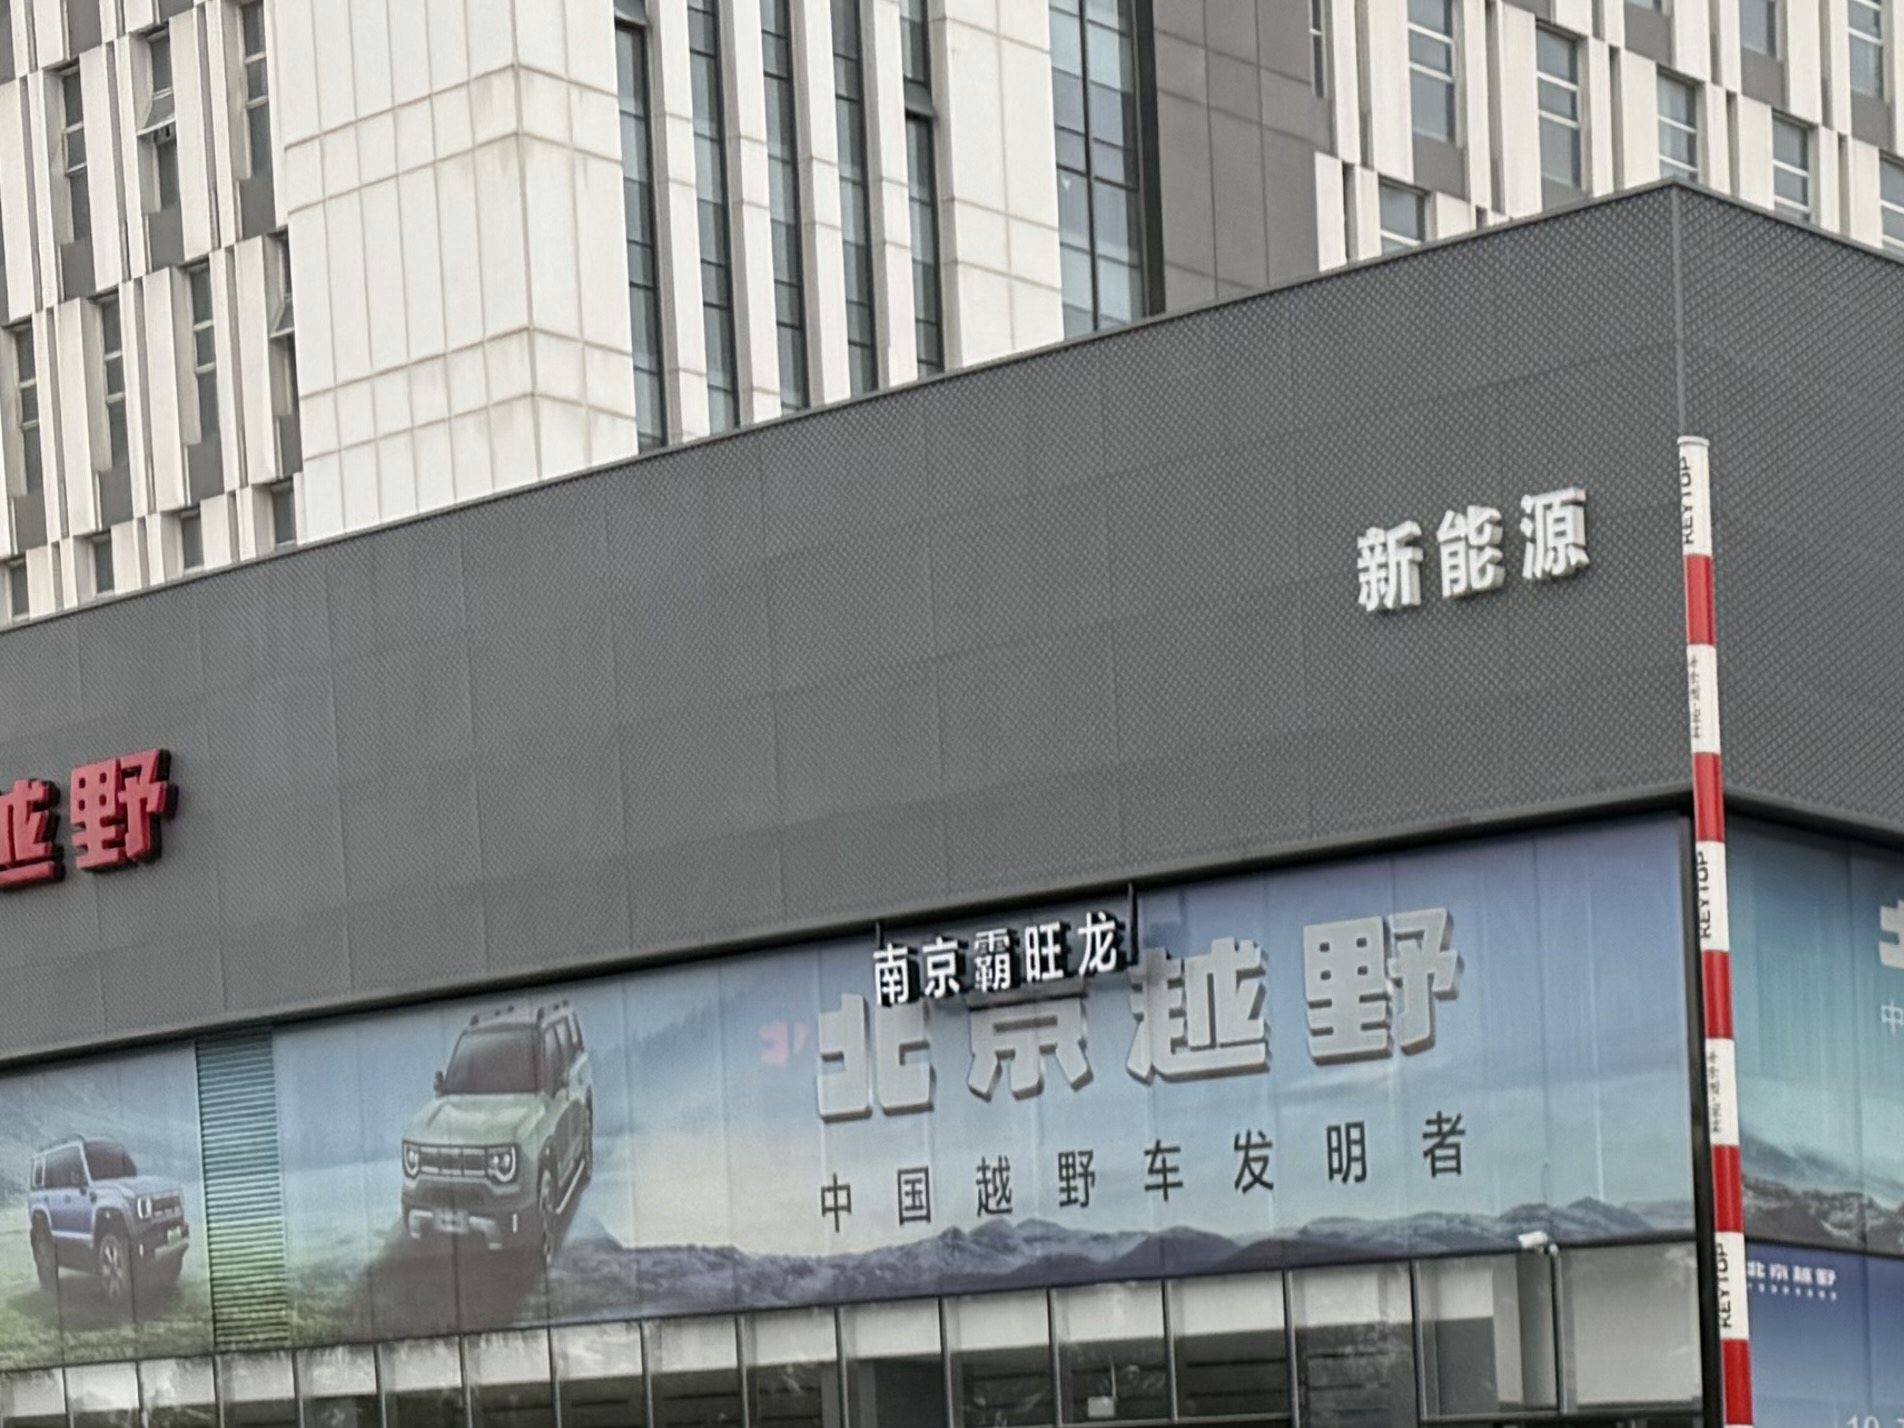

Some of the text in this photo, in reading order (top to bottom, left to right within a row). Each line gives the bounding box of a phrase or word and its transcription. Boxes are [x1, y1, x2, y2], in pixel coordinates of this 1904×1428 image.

[1356, 486, 1590, 612] 新能源
[817, 907, 1464, 1123] 北京越野
[872, 911, 1119, 1008] 南京霸旺龙
[820, 1110, 1468, 1234] 中国越野车发明者
